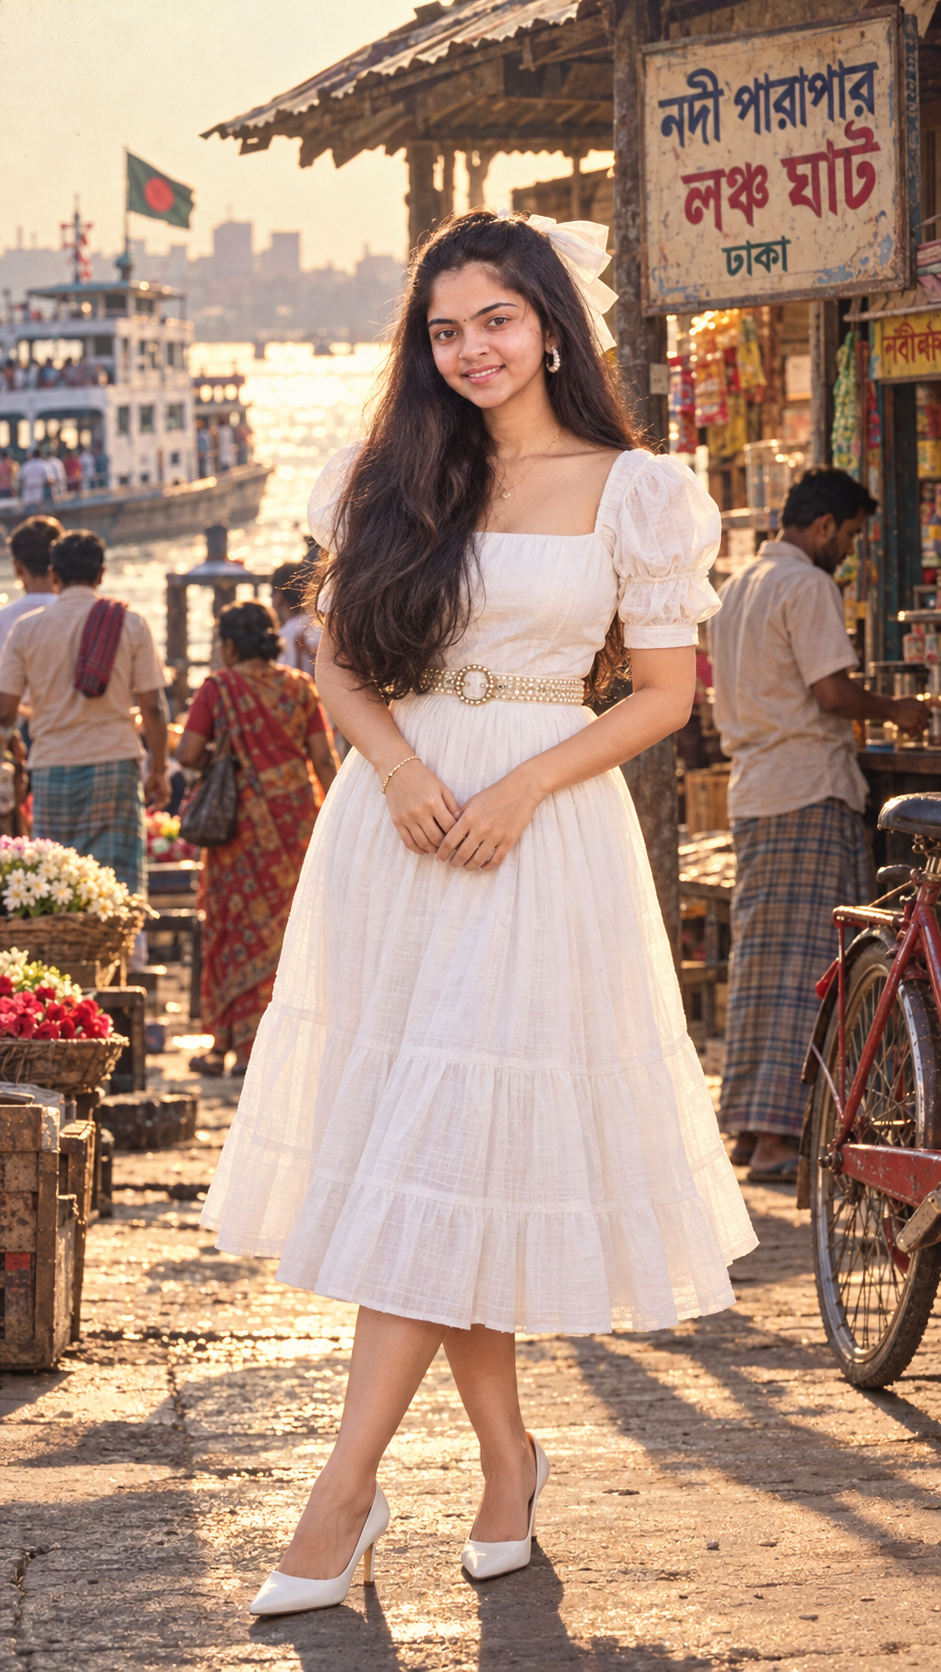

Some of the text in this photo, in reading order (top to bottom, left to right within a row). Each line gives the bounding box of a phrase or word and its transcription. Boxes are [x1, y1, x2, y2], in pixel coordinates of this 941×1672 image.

[658, 68, 725, 148] নদী
[734, 59, 879, 136] পারাপার
[680, 119, 882, 233] লঞ্চ ঘাট
[721, 235, 792, 277] ঢাকা
